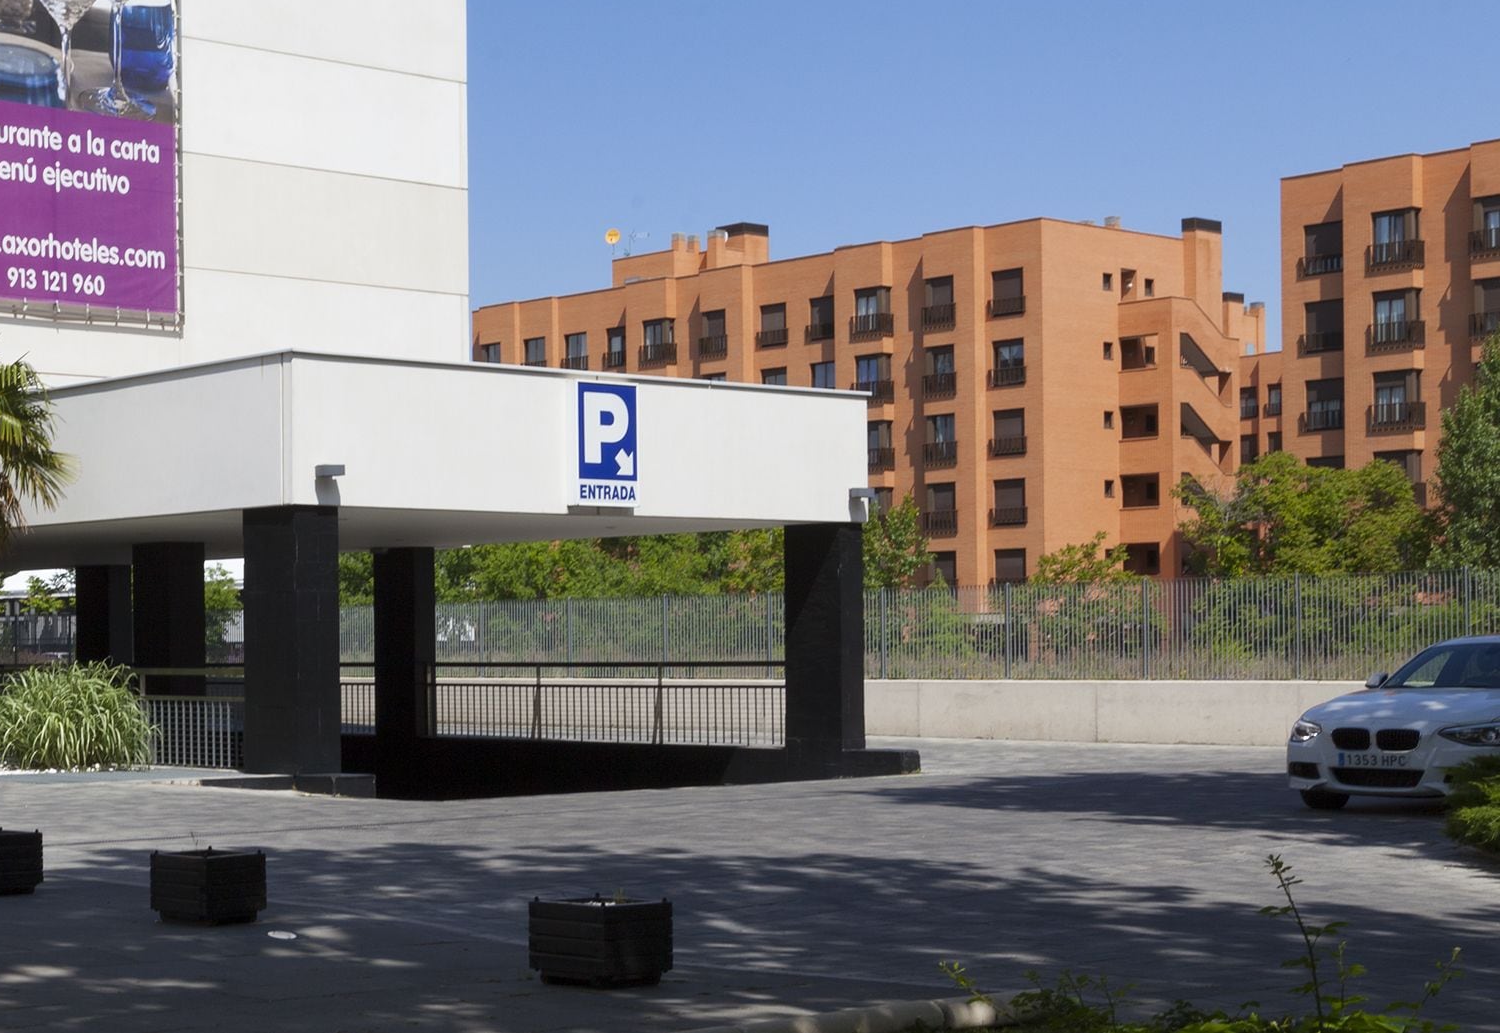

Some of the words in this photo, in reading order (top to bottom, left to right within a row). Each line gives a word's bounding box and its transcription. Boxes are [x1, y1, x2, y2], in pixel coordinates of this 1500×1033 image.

[67, 133, 81, 154] a
[86, 128, 106, 156] la
[110, 138, 160, 164] carta
[42, 160, 131, 194] ejecutivo
[6, 266, 38, 290] 913
[41, 269, 68, 293] 121
[71, 272, 106, 297] 960
[583, 391, 630, 464] P
[579, 484, 637, 501] ENTRADA
[1347, 754, 1378, 766] 1353
[1381, 754, 1407, 767] HPC
